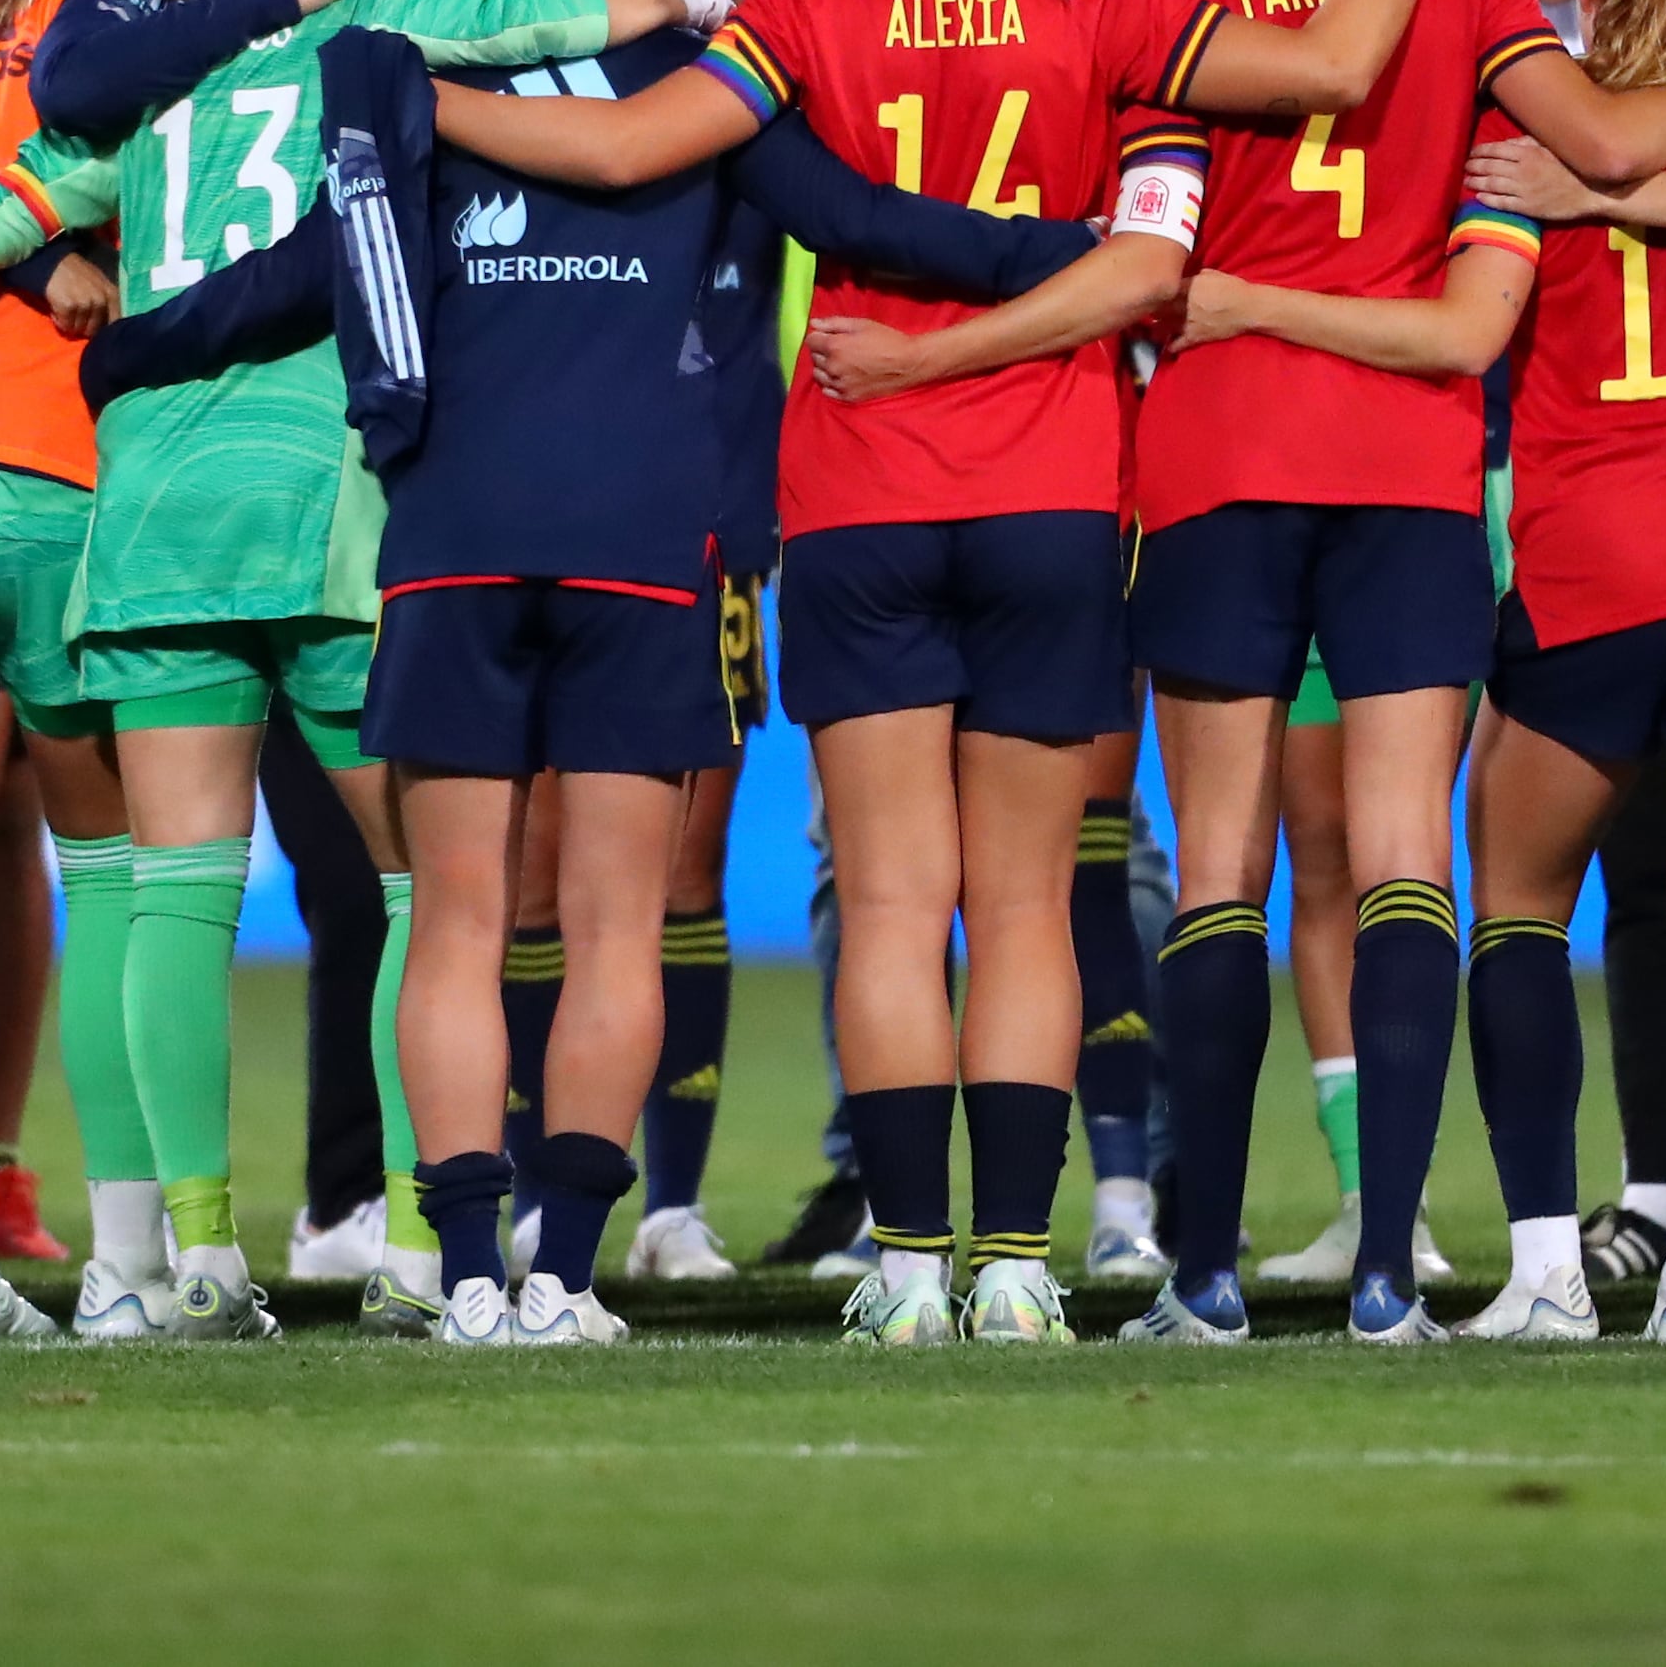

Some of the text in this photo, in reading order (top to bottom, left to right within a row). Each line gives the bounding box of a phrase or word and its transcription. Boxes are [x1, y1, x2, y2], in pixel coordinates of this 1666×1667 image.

[150, 84, 301, 293] 13
[878, 90, 1041, 220] 14
[1290, 113, 1365, 239] 4
[467, 255, 649, 285] IBERDROLA
